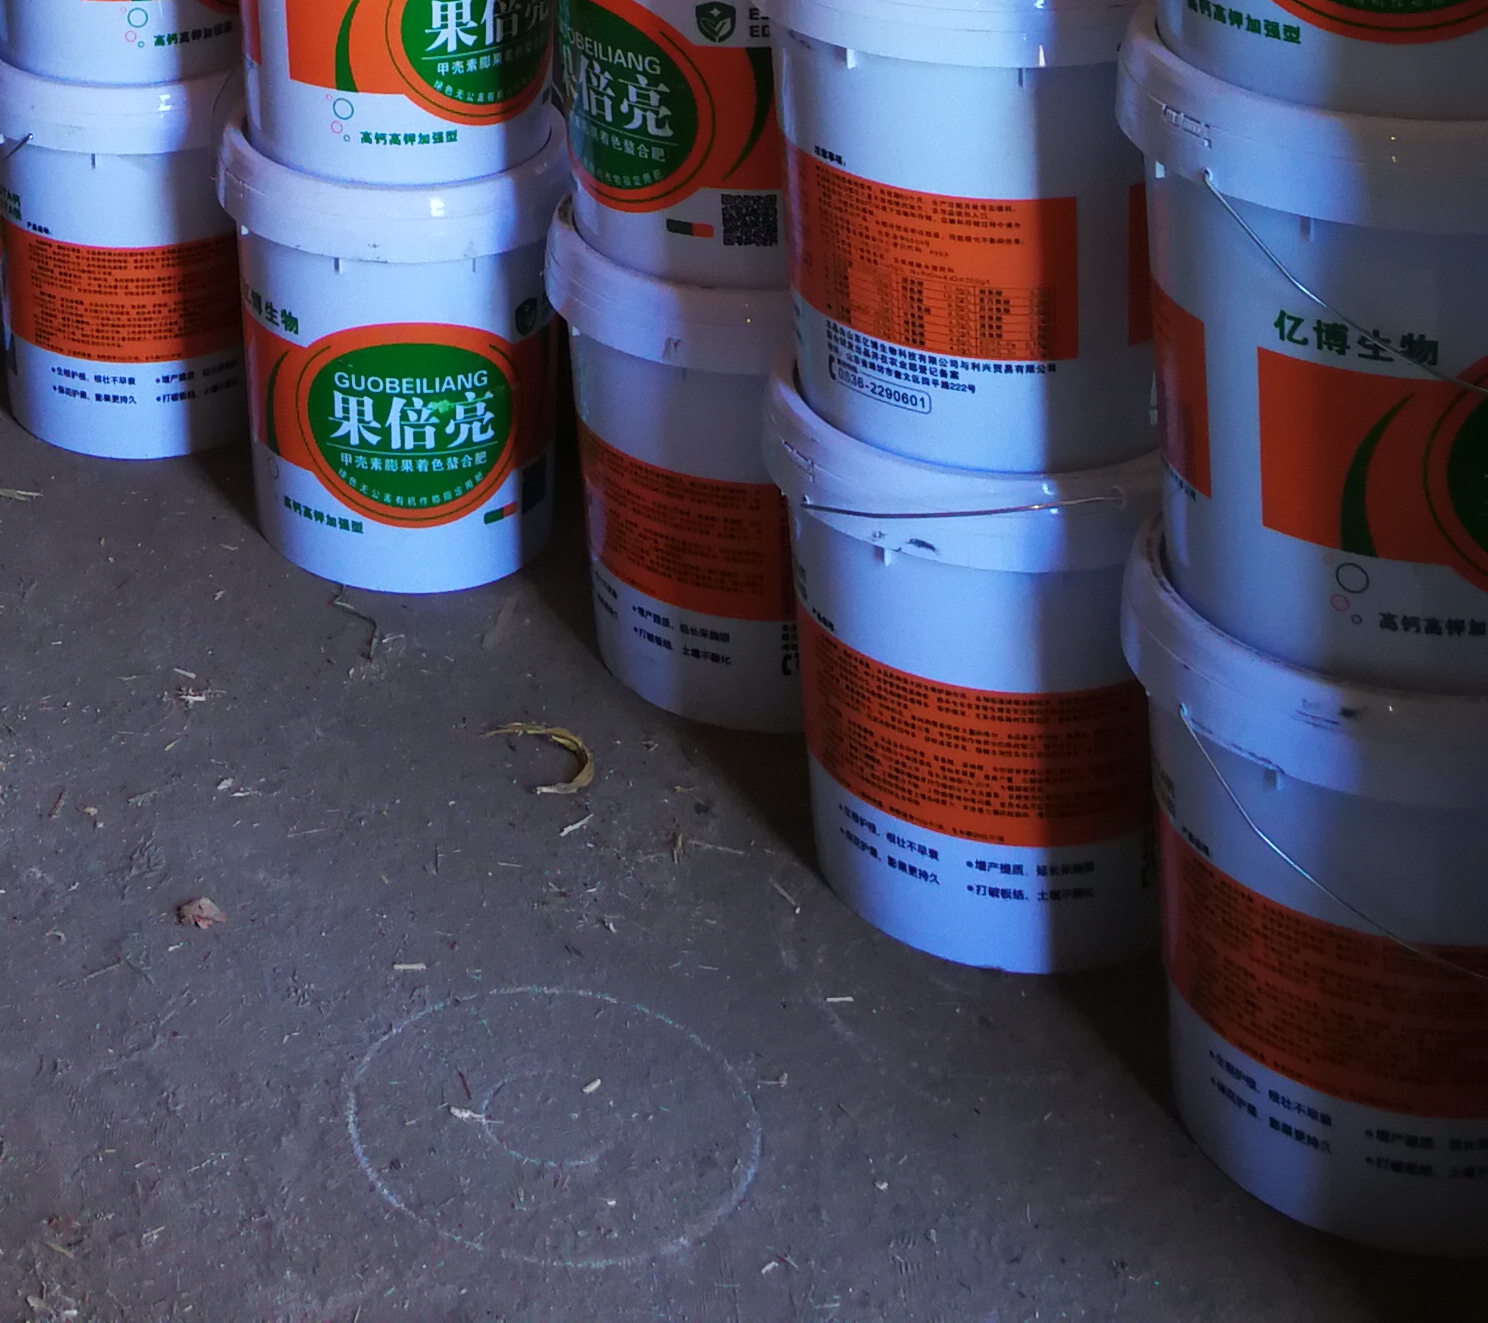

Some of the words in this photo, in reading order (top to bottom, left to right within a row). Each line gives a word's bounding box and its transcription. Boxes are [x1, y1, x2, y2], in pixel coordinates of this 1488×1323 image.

[360, 129, 459, 145] 高钙高钾加强型
[1274, 310, 1439, 366] 亿博生物
[334, 370, 489, 394] GUOBEILIANG
[838, 366, 926, 408] 0536-2290601
[328, 390, 495, 451] 果倍亮
[340, 451, 487, 473] 甲壳素膨果着色螯合肥
[284, 496, 364, 534] 高钙高钾加强型
